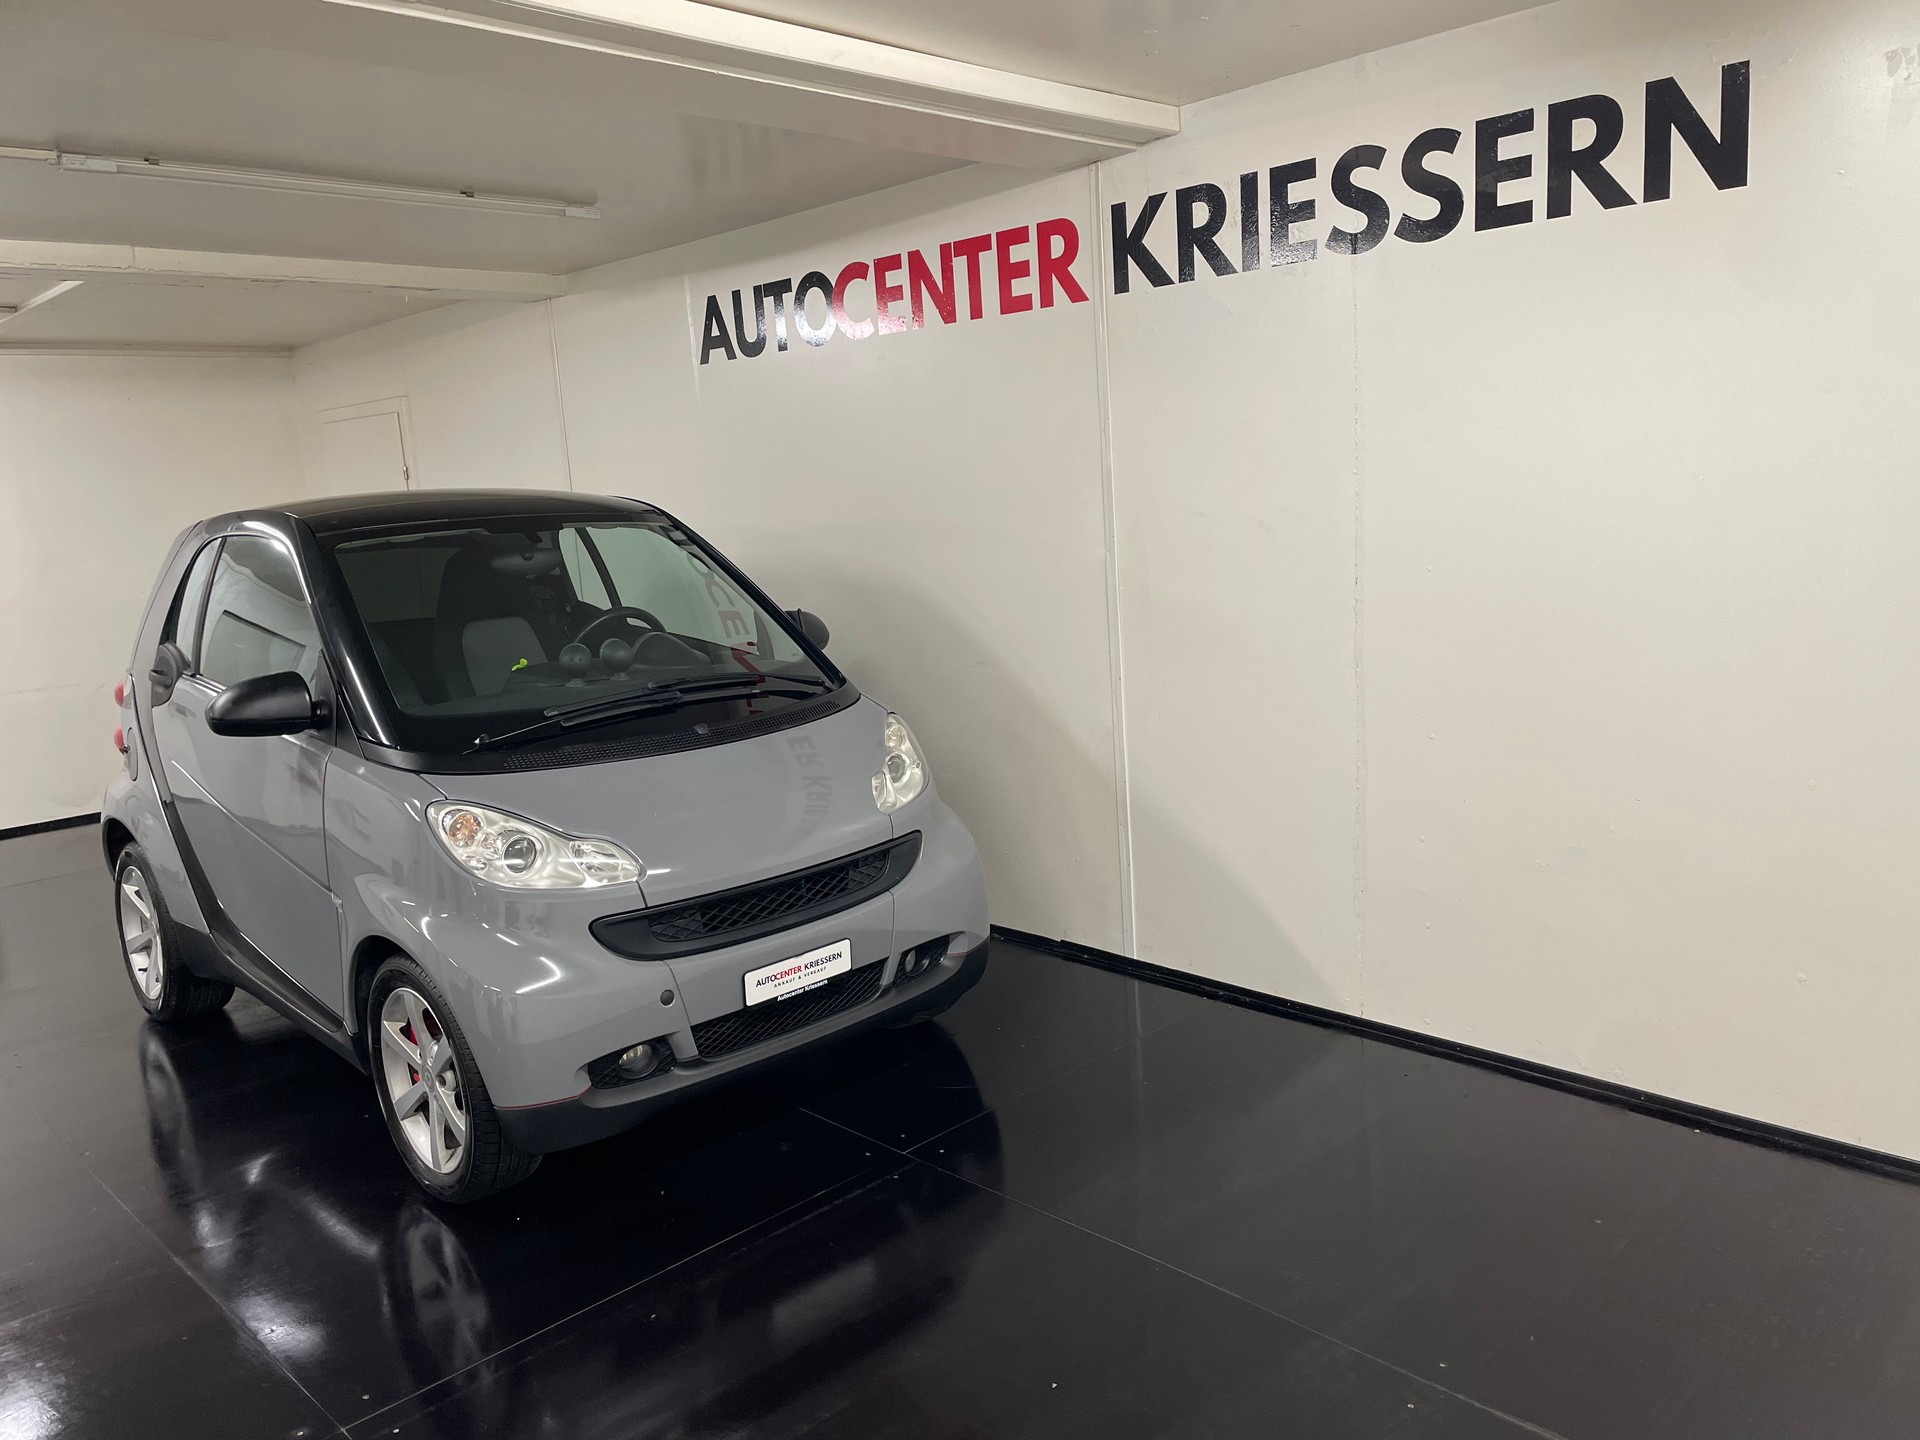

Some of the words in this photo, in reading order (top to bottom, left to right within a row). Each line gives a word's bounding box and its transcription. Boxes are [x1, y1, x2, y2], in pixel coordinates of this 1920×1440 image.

[700, 217, 1090, 365] AUTOCENTER
[1111, 60, 1751, 295] KRIESSERN
[756, 965, 802, 988] AUTOCENTER
[804, 951, 842, 970] KRIESSERN
[774, 976, 796, 988] ANKAUF
[804, 966, 827, 978] VERKAUF
[777, 987, 804, 1001] Autocenter
[804, 979, 828, 991] Kriessern
